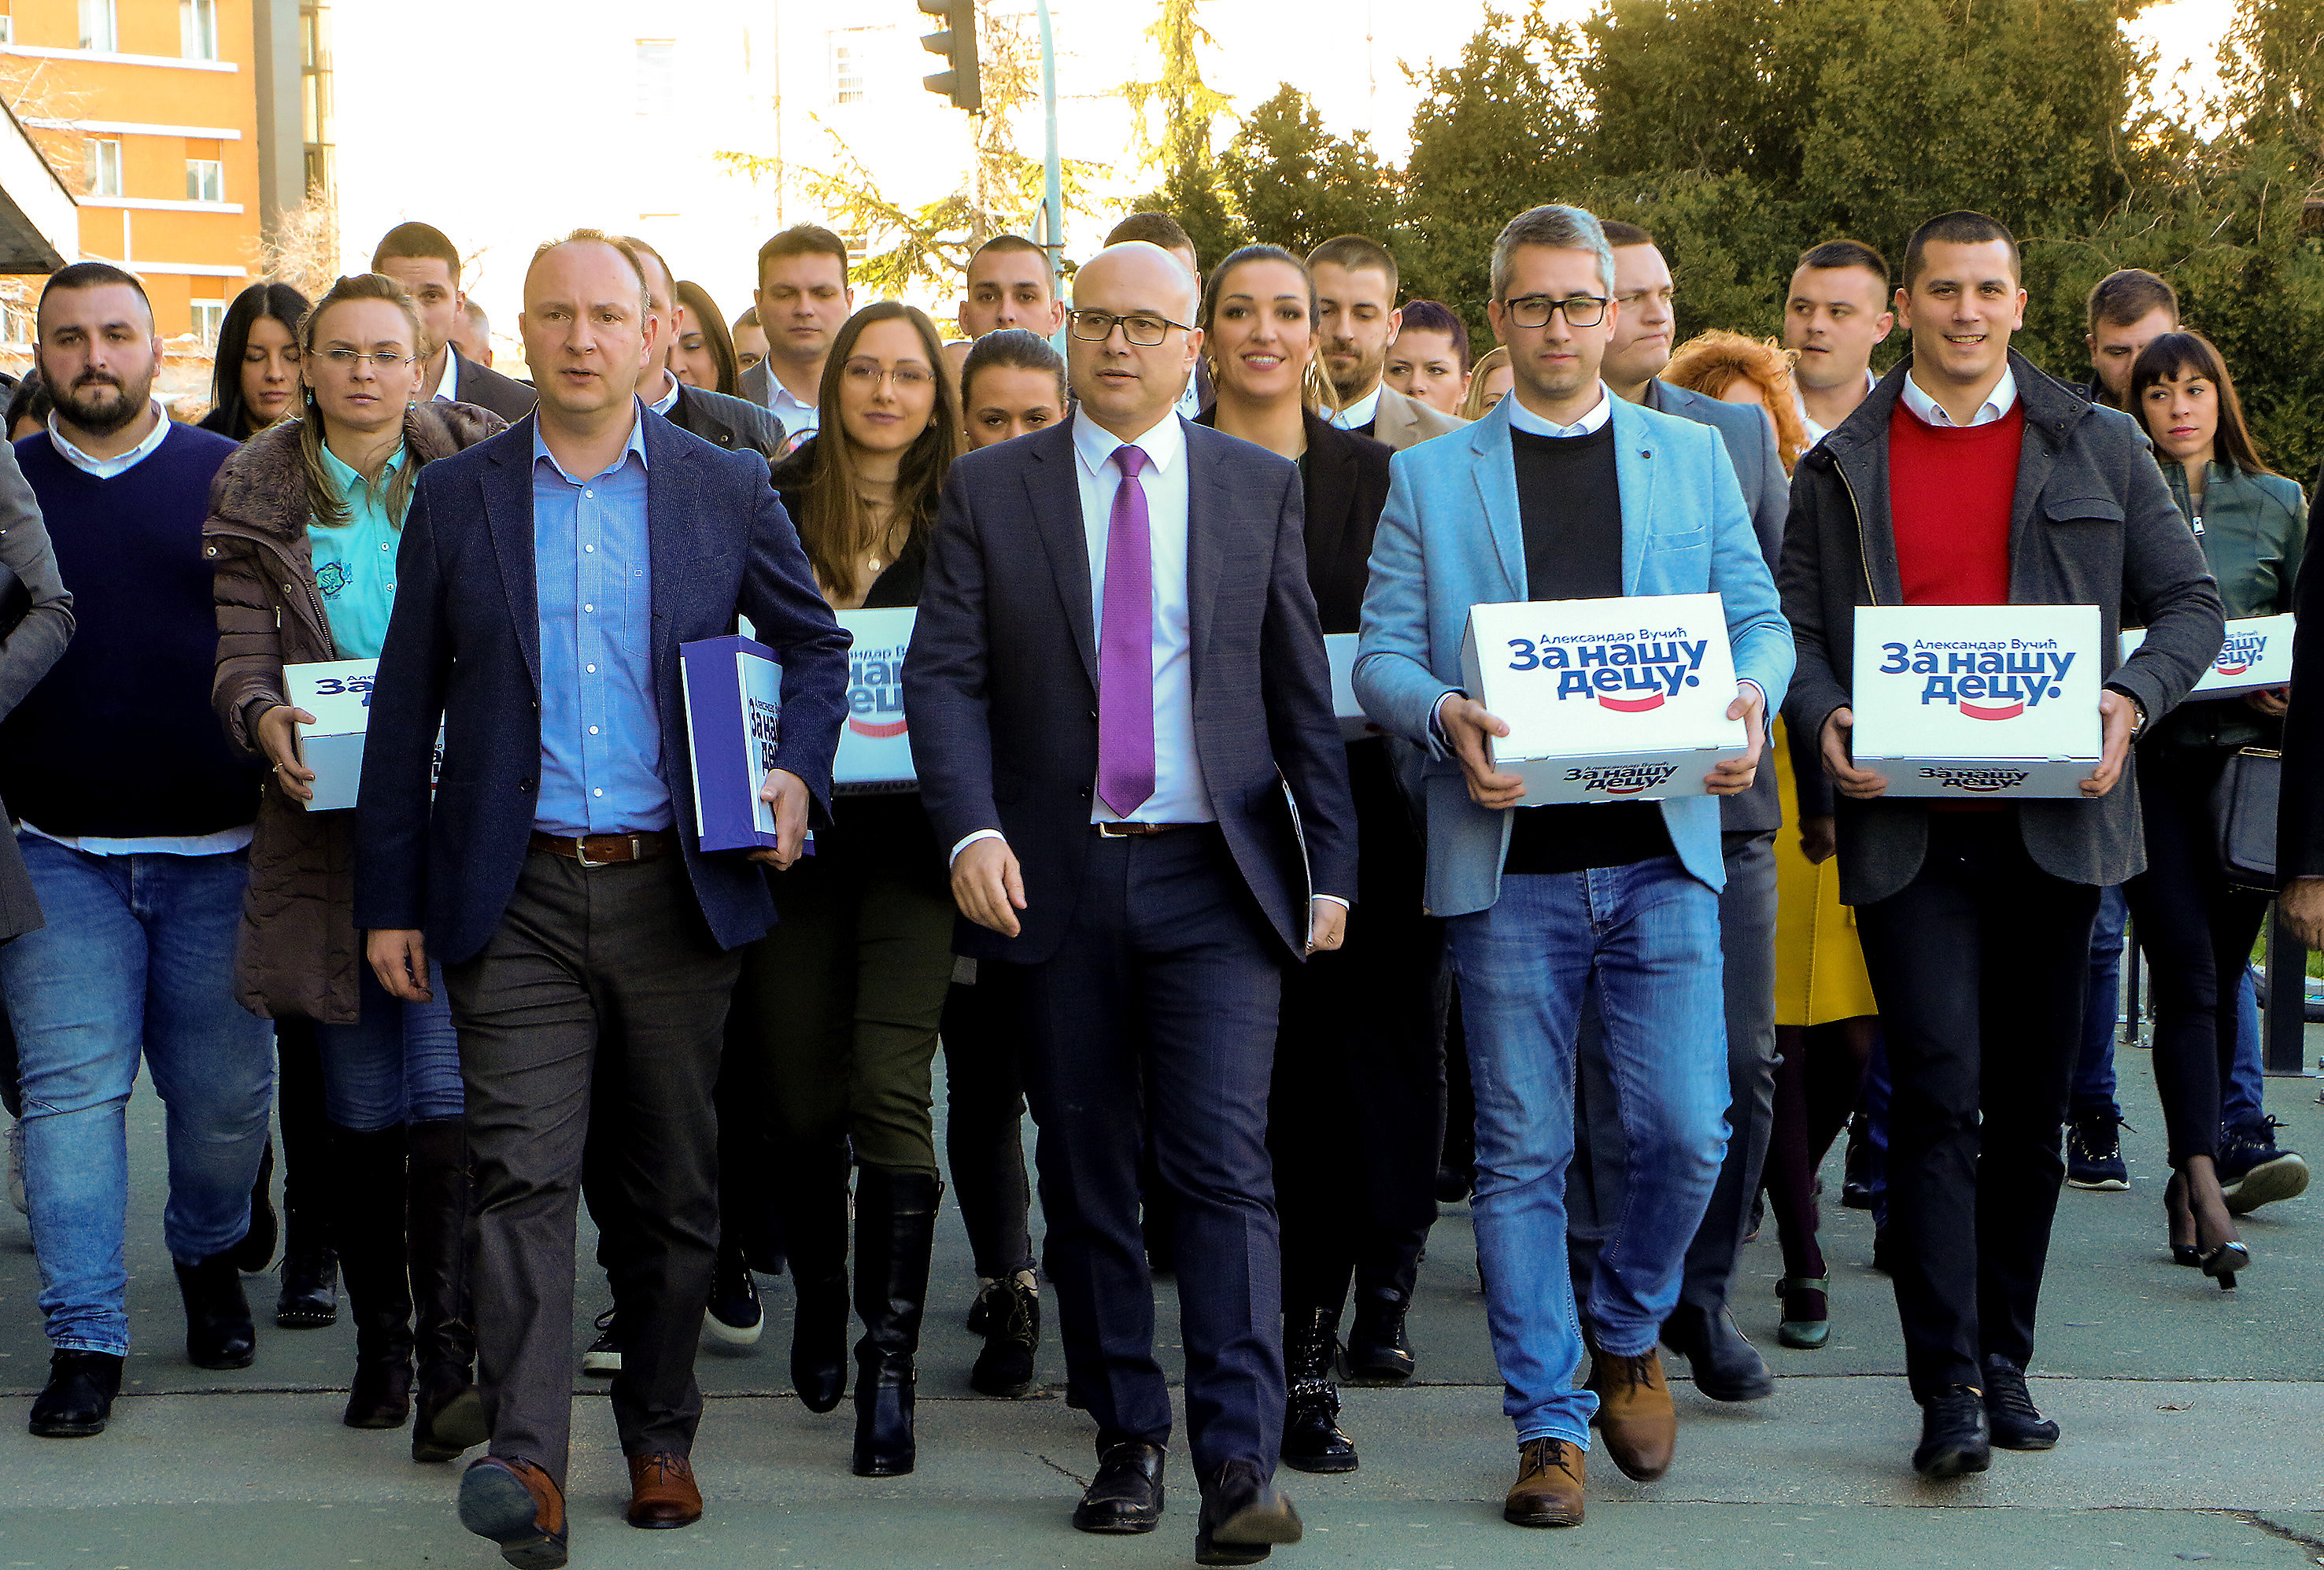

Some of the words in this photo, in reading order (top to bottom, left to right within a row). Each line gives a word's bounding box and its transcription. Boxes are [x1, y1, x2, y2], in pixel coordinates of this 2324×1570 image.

[1540, 630, 1635, 645] Александар
[1640, 627, 1687, 640] Вучић
[1913, 639, 2006, 651] Александар
[2012, 638, 2057, 651] Вучић
[2222, 636, 2267, 652] ашу
[1507, 638, 1569, 670] За
[1578, 639, 1708, 670] нашу
[1879, 642, 1938, 674] За
[1948, 652, 2076, 682] нашу
[315, 678, 373, 695] За
[749, 697, 763, 739] За
[1563, 767, 1598, 781] За
[1603, 765, 1679, 778] нашу
[1919, 767, 1952, 778] За
[1957, 770, 2029, 781] нашу
